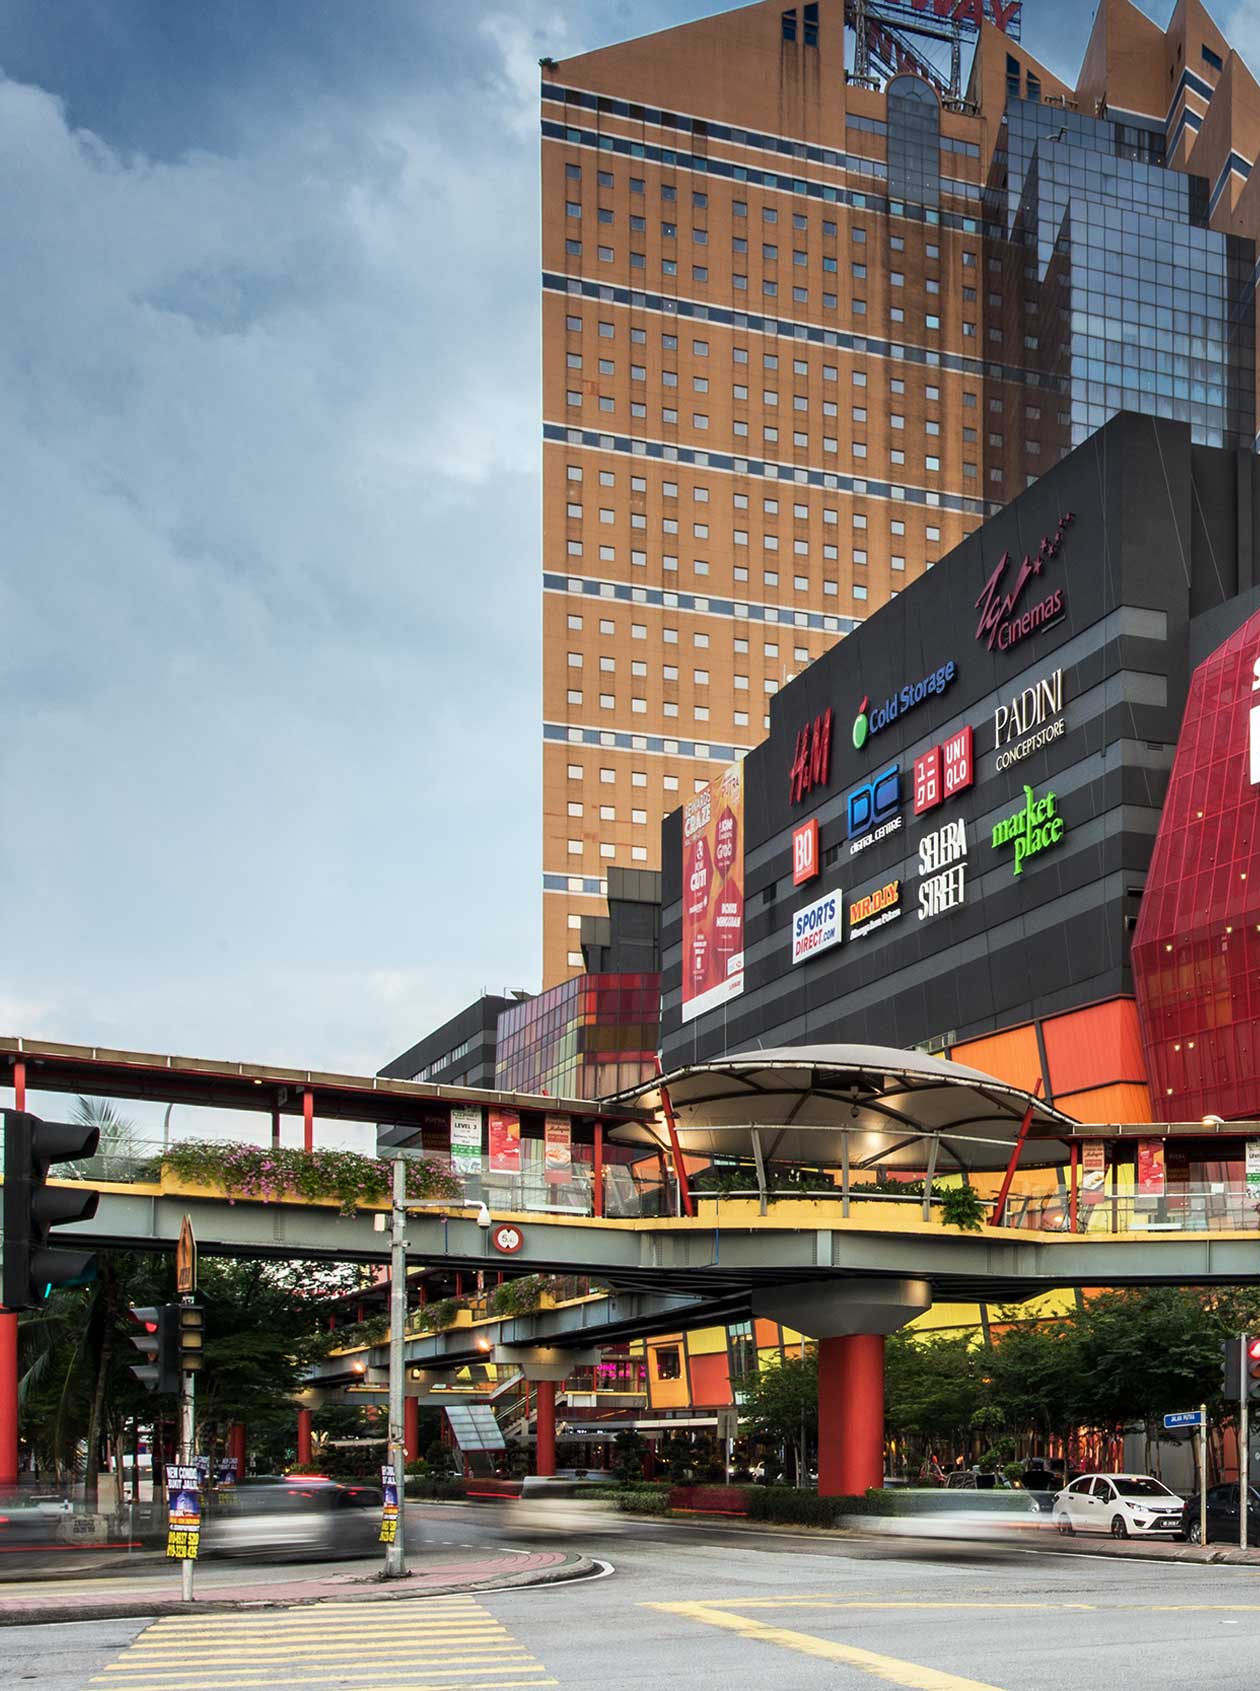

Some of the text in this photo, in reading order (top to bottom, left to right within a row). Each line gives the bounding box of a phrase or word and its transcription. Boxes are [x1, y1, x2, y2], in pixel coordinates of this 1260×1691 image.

[998, 589, 1063, 651] Cinemas
[869, 661, 955, 734] Cold Storage
[995, 668, 1064, 750] PADINI
[789, 706, 832, 808] H&M
[946, 736, 965, 764] UNI
[946, 760, 967, 791] QLO
[848, 764, 900, 840] DC
[991, 785, 1057, 848] market
[918, 818, 968, 876] SELERA
[1013, 817, 1064, 876] place
[796, 898, 836, 938] SPORTS
[918, 862, 968, 921] STREET
